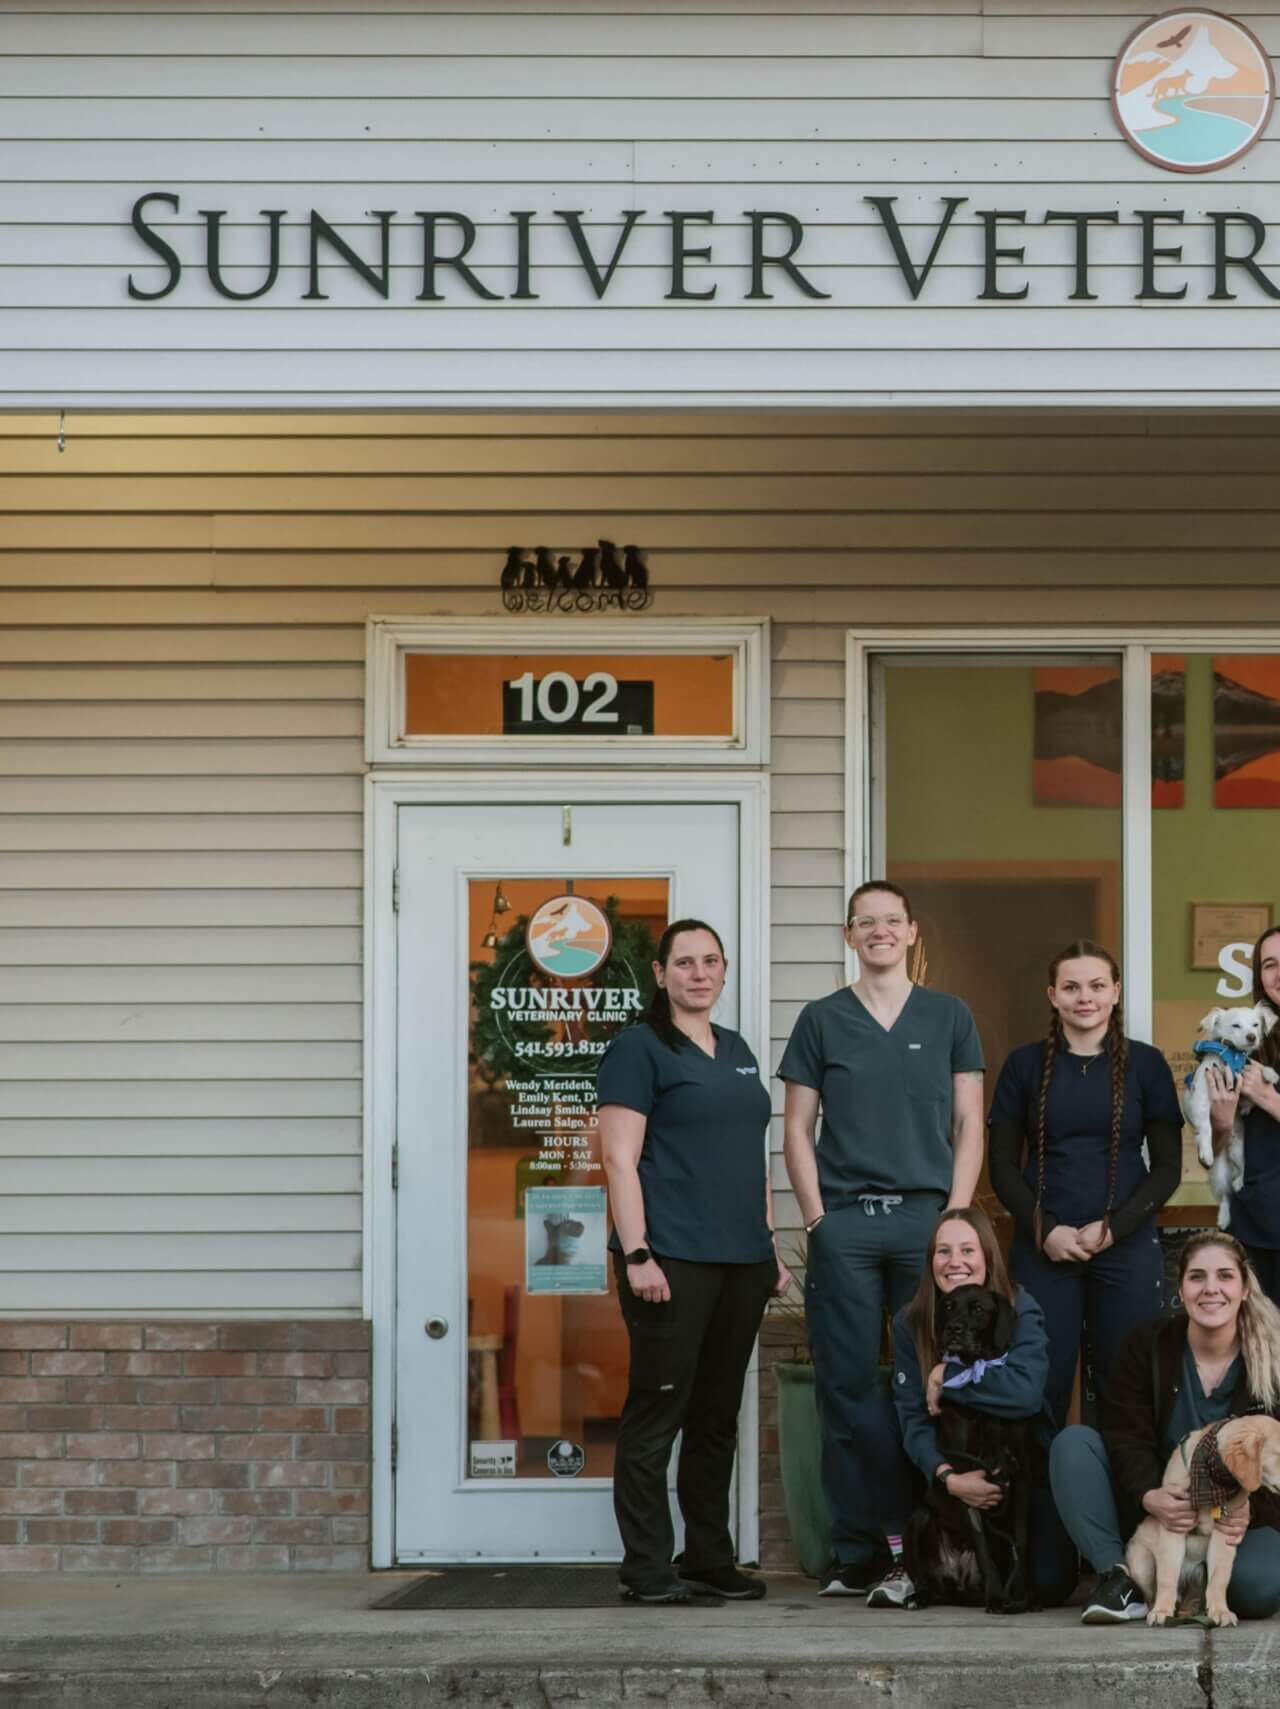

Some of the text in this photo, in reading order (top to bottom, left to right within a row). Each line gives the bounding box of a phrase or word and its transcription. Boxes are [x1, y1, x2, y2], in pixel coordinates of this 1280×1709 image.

[128, 191, 832, 300] SUNRIVER
[509, 671, 619, 723] 102
[490, 987, 643, 1010] SUNRIVER
[507, 1010, 627, 1022] VETERINARY CLINIC
[505, 1080, 595, 1092] Wendy Merideth,
[519, 1092, 550, 1104] Emily
[552, 1092, 582, 1103] Kent,
[510, 1104, 552, 1116] Lindsay
[554, 1104, 589, 1116] Smith,
[513, 1117, 551, 1127] Lauren
[543, 1136, 588, 1147] HOURS
[539, 1151, 565, 1160] MON
[573, 1151, 592, 1160] SAT
[529, 1161, 561, 1170] 8:00am
